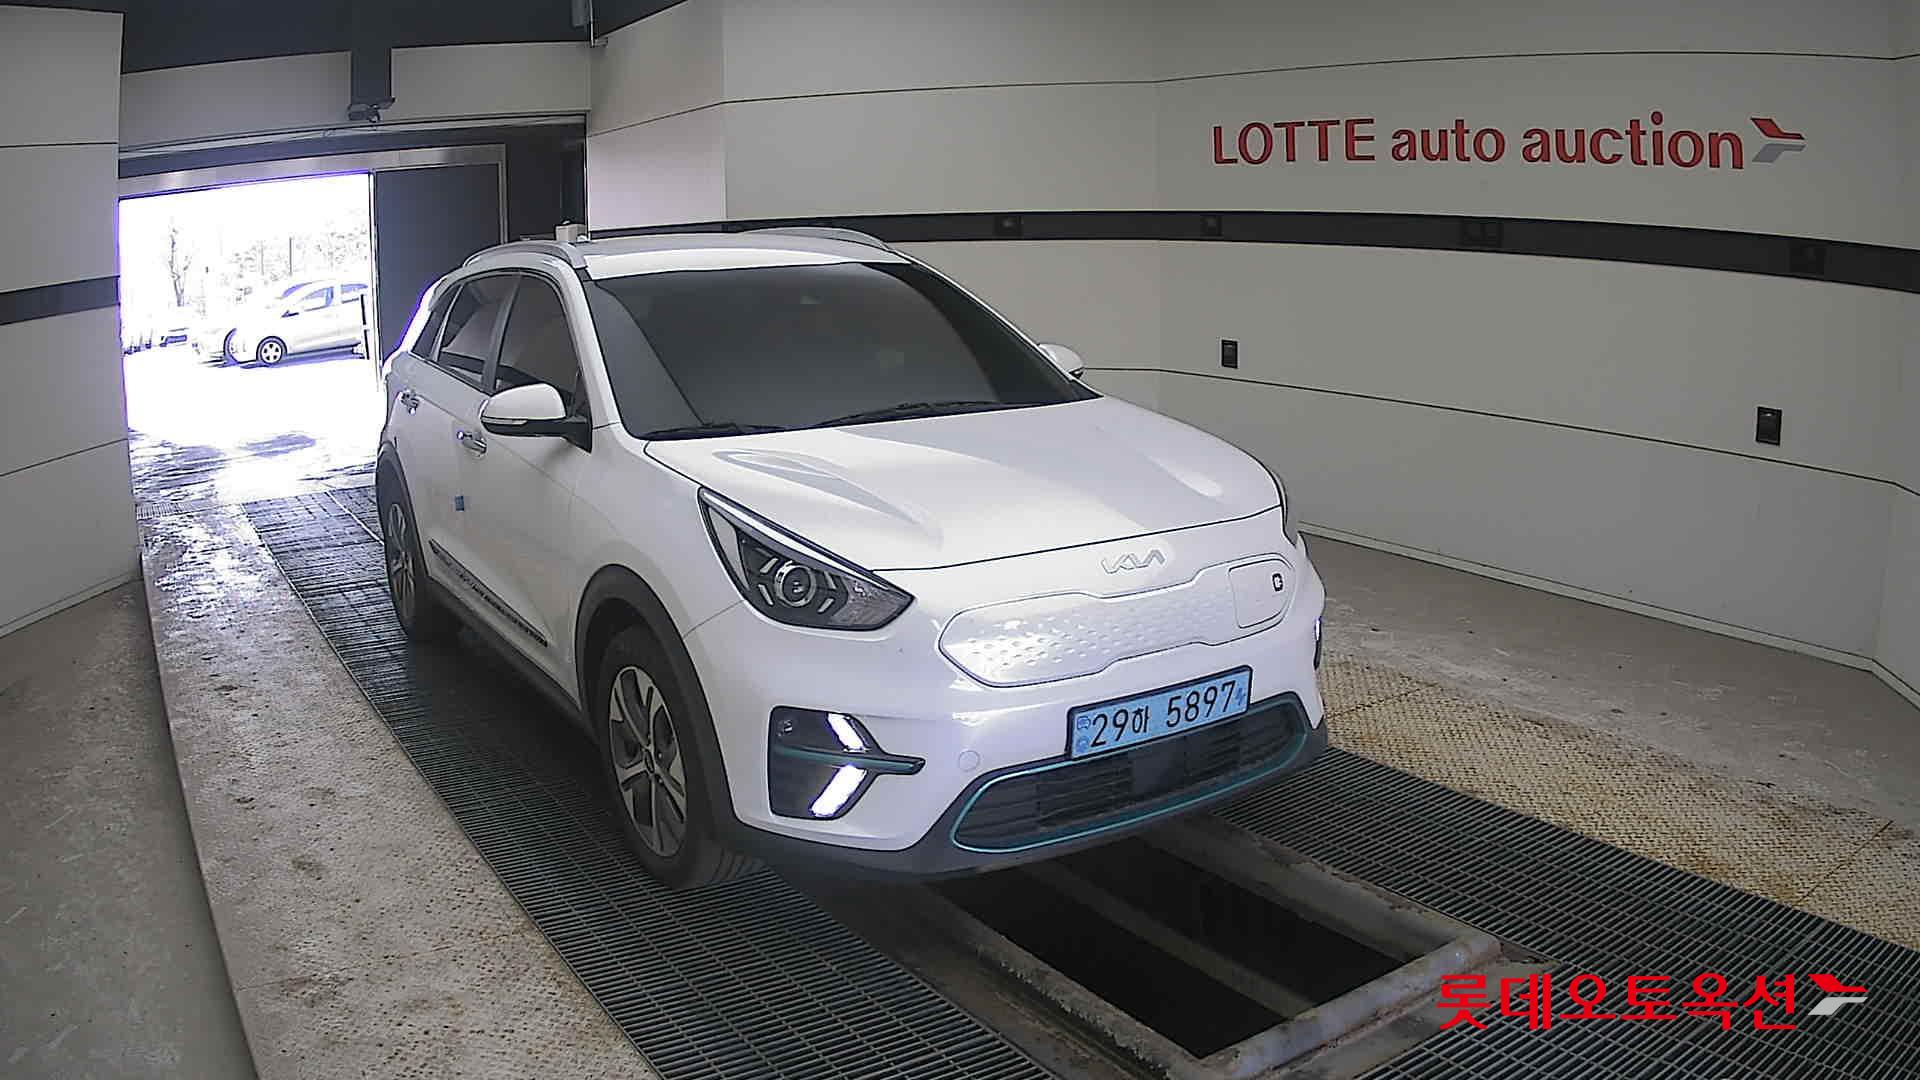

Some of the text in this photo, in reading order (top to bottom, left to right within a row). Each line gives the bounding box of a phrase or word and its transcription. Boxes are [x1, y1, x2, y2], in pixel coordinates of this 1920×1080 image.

[1213, 111, 1744, 170] LOTTE auto auction
[1101, 549, 1166, 574] KIA
[1091, 680, 1237, 747] 29하 5897
